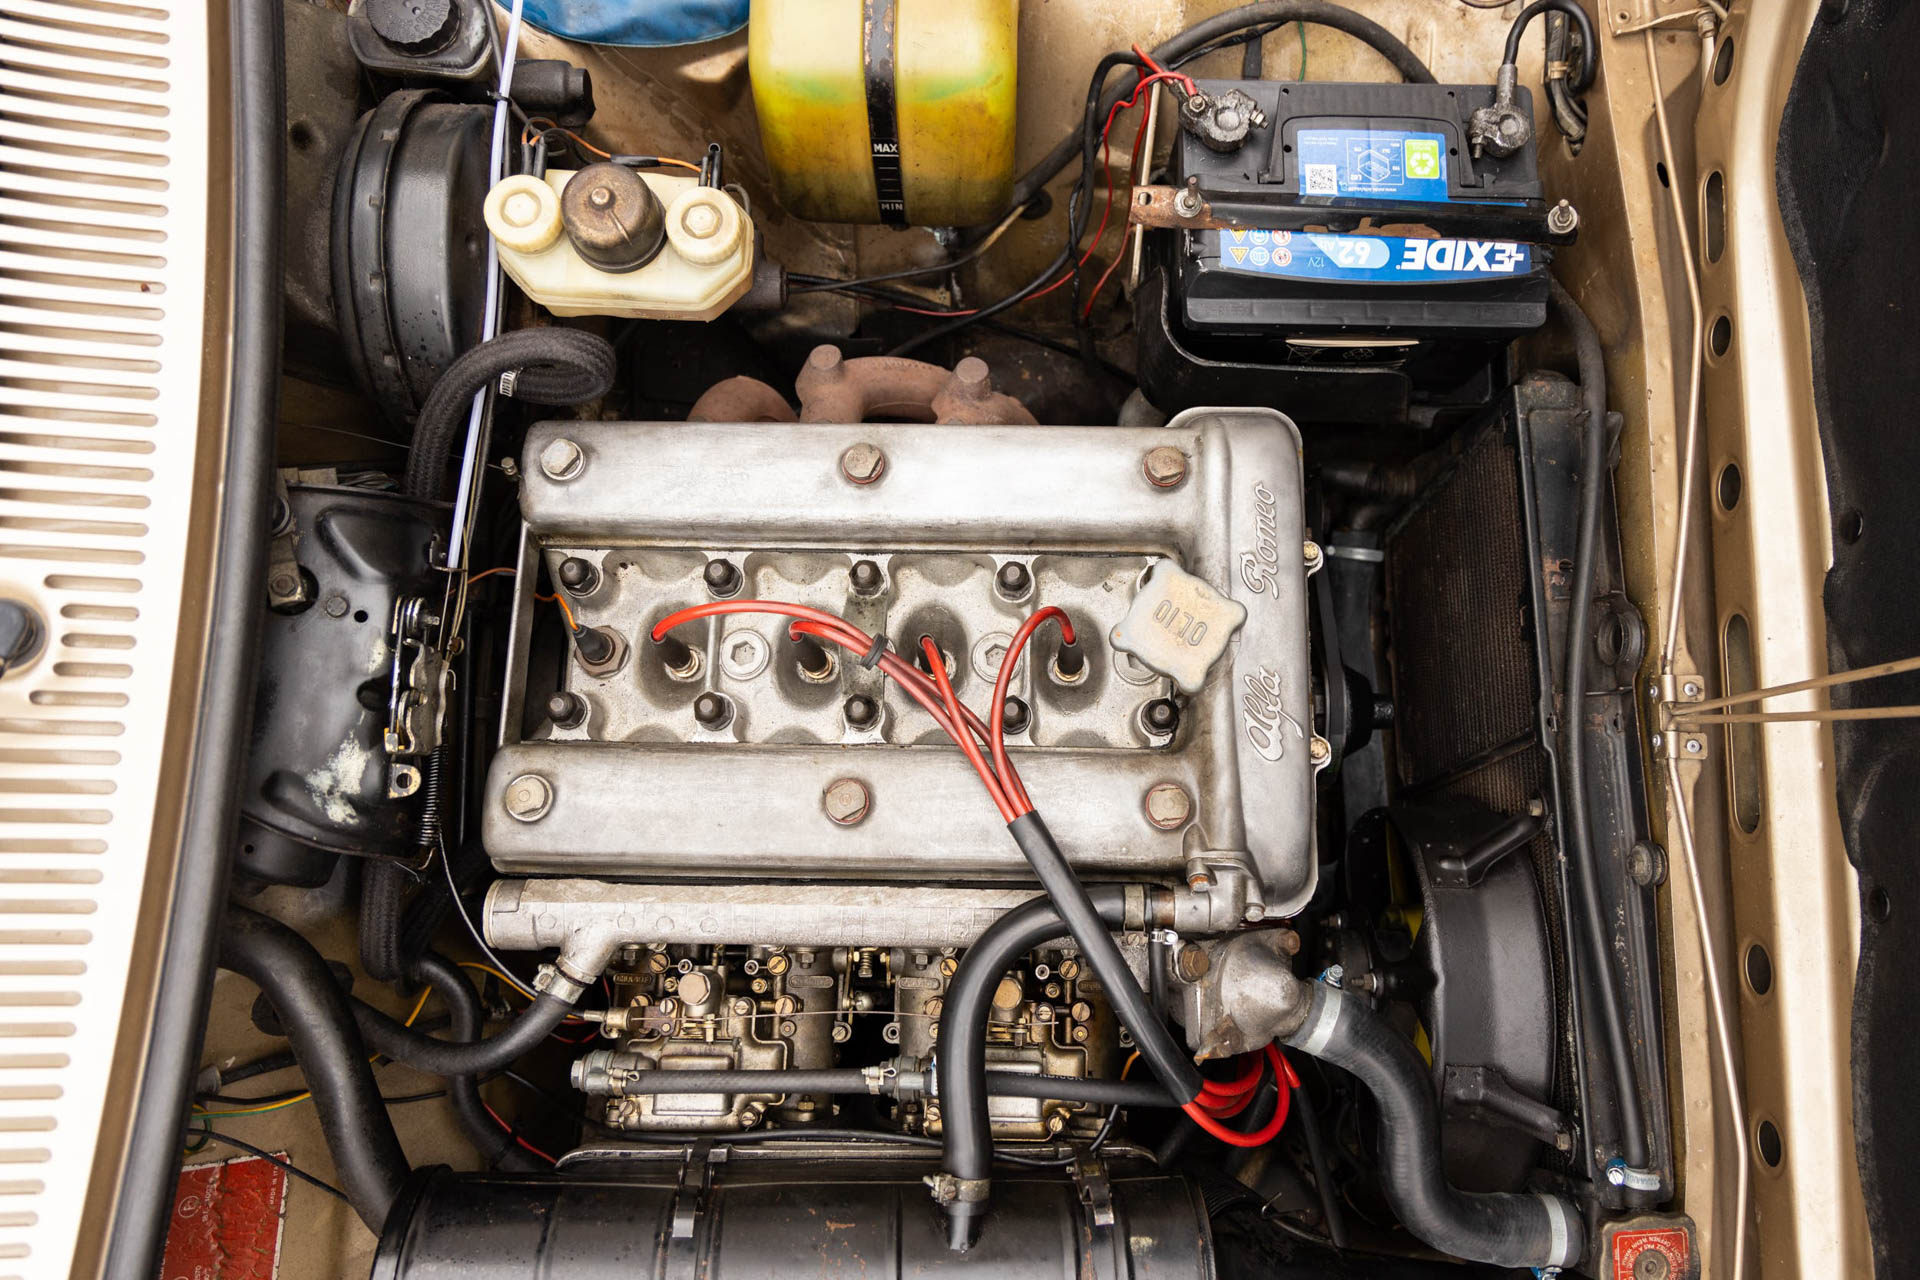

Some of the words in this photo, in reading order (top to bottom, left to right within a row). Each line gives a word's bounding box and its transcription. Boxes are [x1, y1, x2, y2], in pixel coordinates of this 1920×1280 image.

[873, 143, 898, 153] MAX
[881, 203, 903, 211] MIN
[1307, 256, 1325, 268] 12V
[1339, 241, 1371, 264] 62
[1400, 238, 1525, 272] EXIDE
[1239, 480, 1279, 600] Romeo
[1152, 599, 1208, 647] OLIO
[1242, 665, 1304, 762] Alfa
